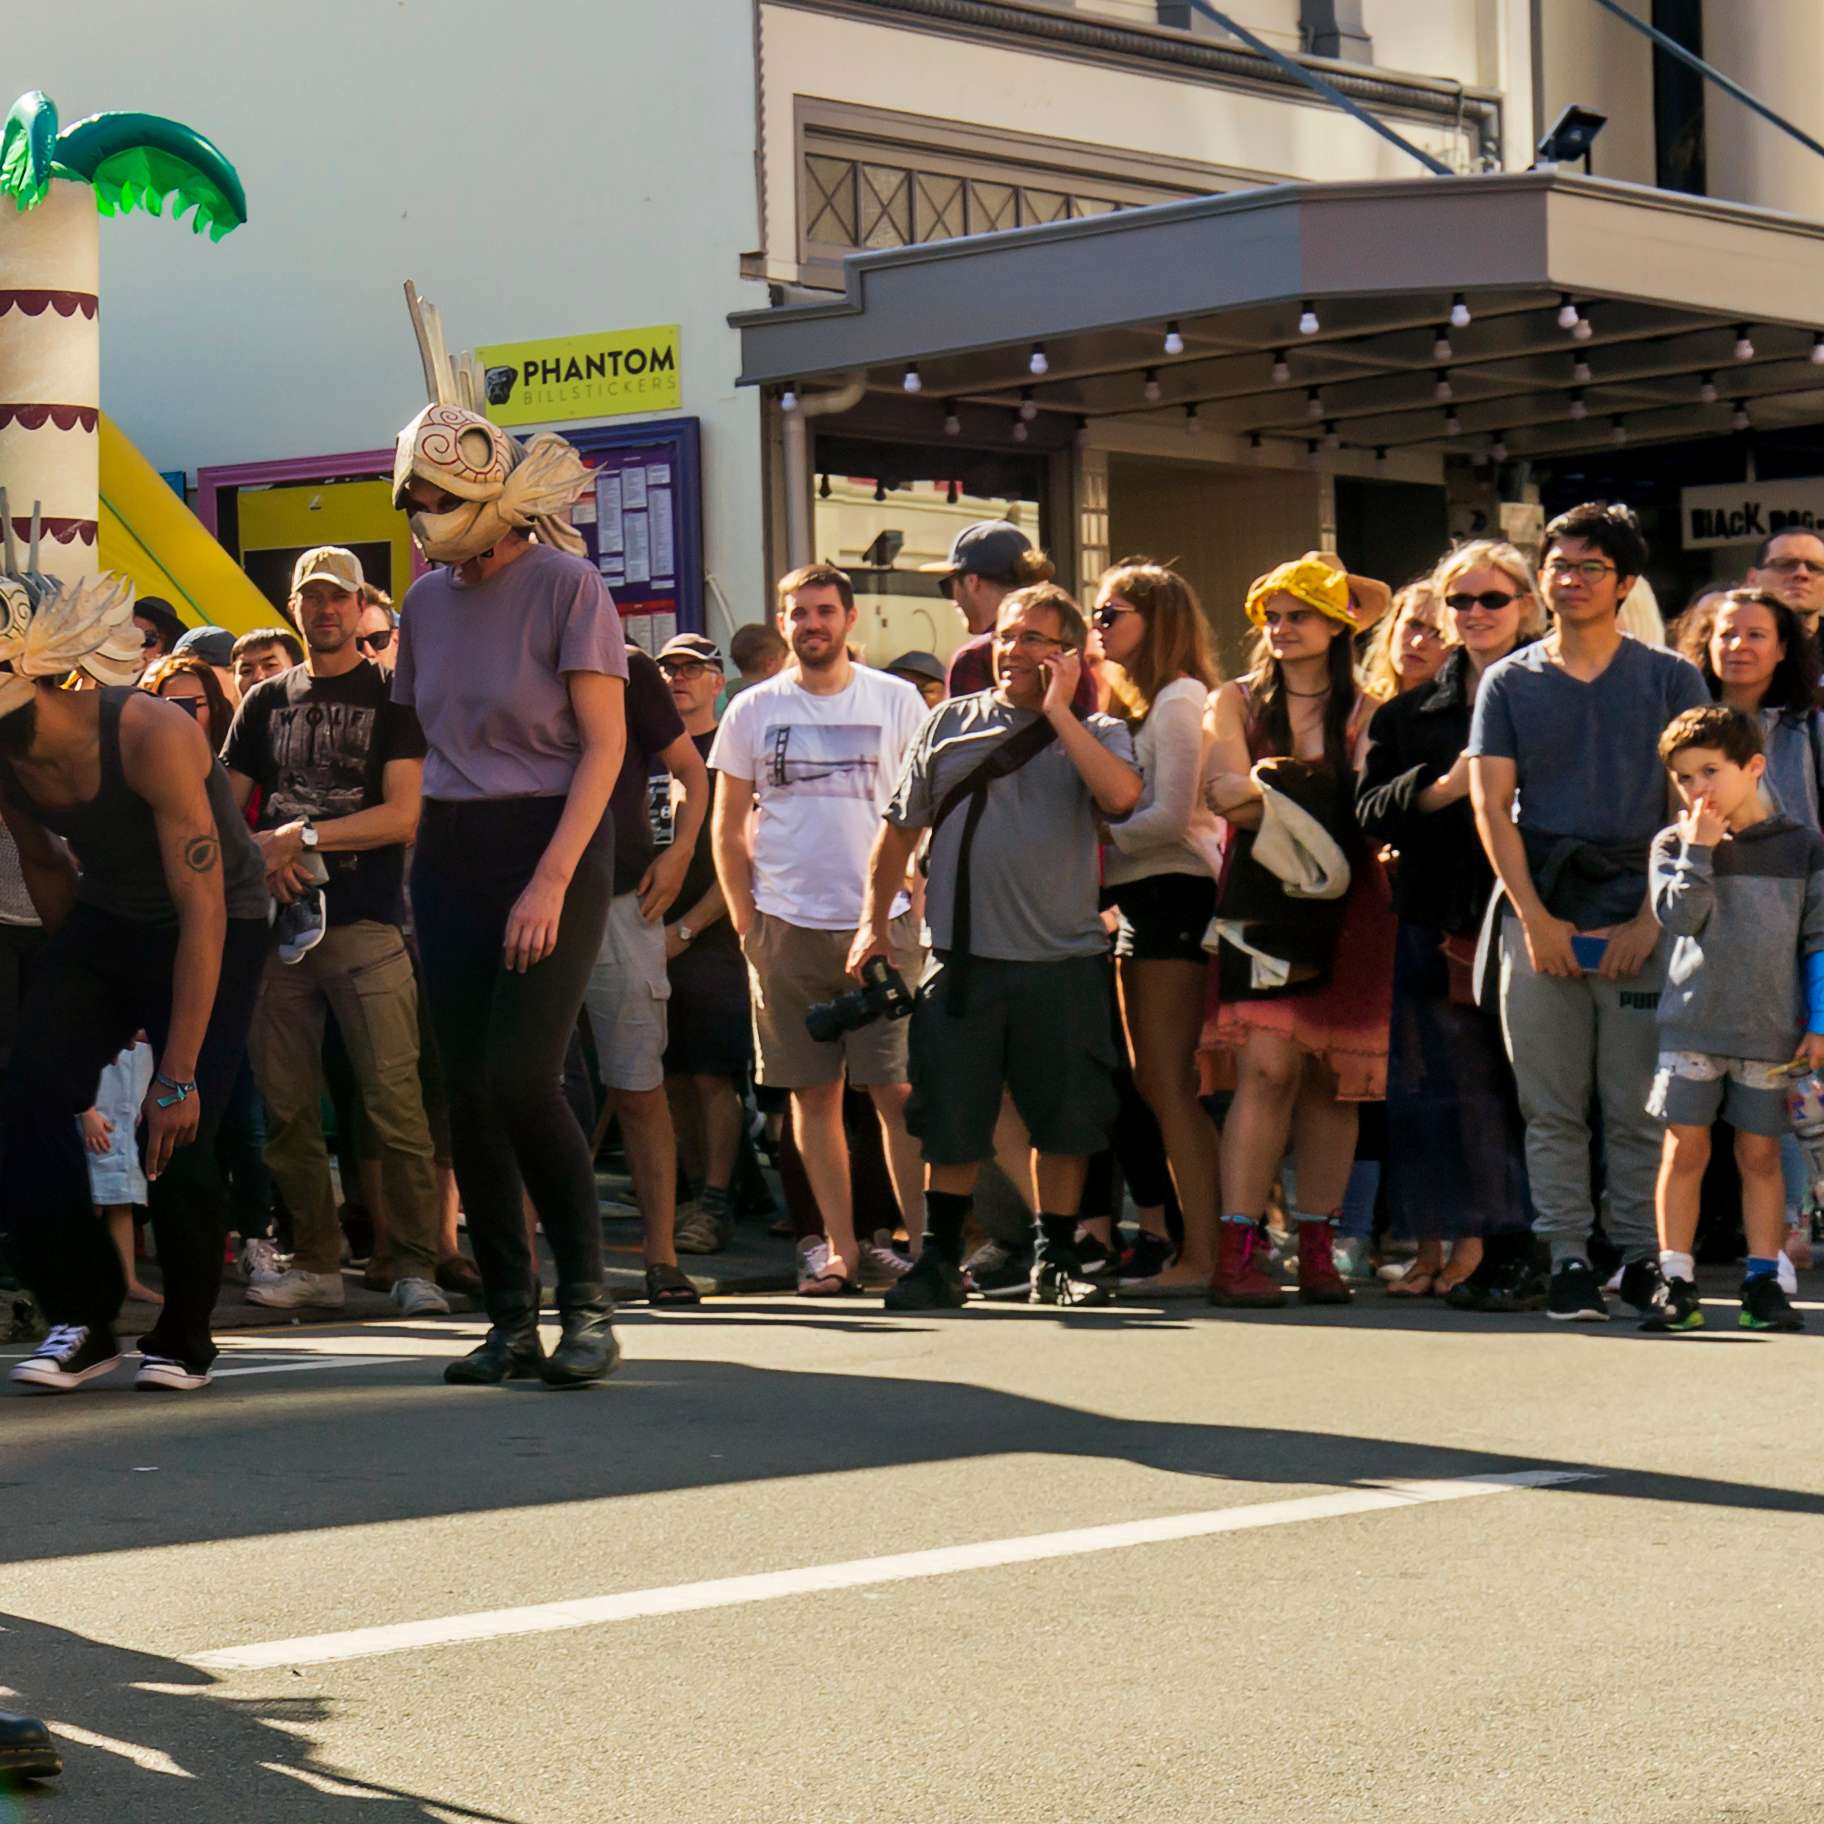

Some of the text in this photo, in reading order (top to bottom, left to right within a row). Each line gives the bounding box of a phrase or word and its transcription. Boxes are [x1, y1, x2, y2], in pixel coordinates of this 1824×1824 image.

[523, 344, 675, 387] PHANTOM
[523, 375, 676, 406] BILLSTICKERS
[280, 705, 365, 727] WOLF
